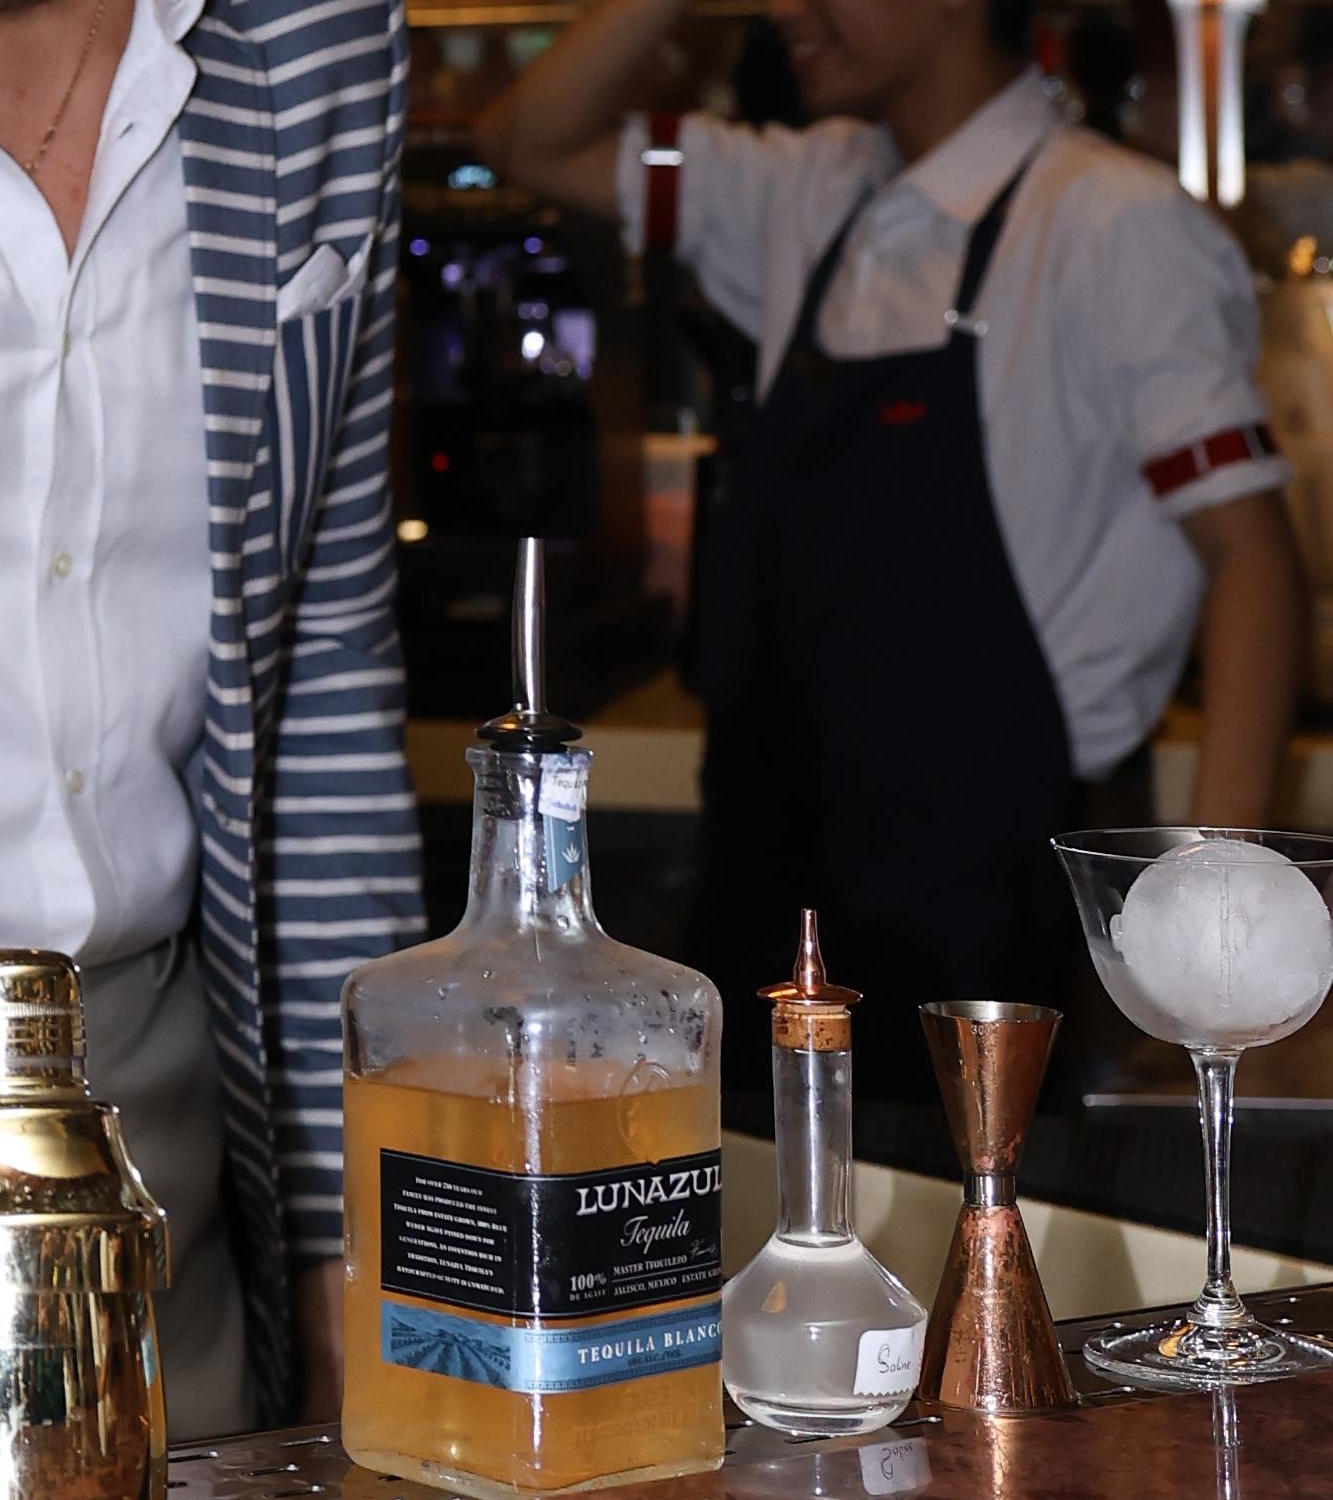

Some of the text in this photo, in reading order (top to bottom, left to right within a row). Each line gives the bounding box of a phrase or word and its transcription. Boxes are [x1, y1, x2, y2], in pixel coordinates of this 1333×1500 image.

[576, 1164, 723, 1216] LUNAZUL
[620, 1208, 691, 1255] Tequila
[613, 1254, 687, 1276] MASTER TEQUILERO
[570, 1272, 607, 1292] 100%
[648, 1276, 677, 1289] MEXICO
[681, 1270, 707, 1284] ESTATE
[578, 1336, 655, 1364] TEQUILA
[877, 1343, 911, 1374] Saline
